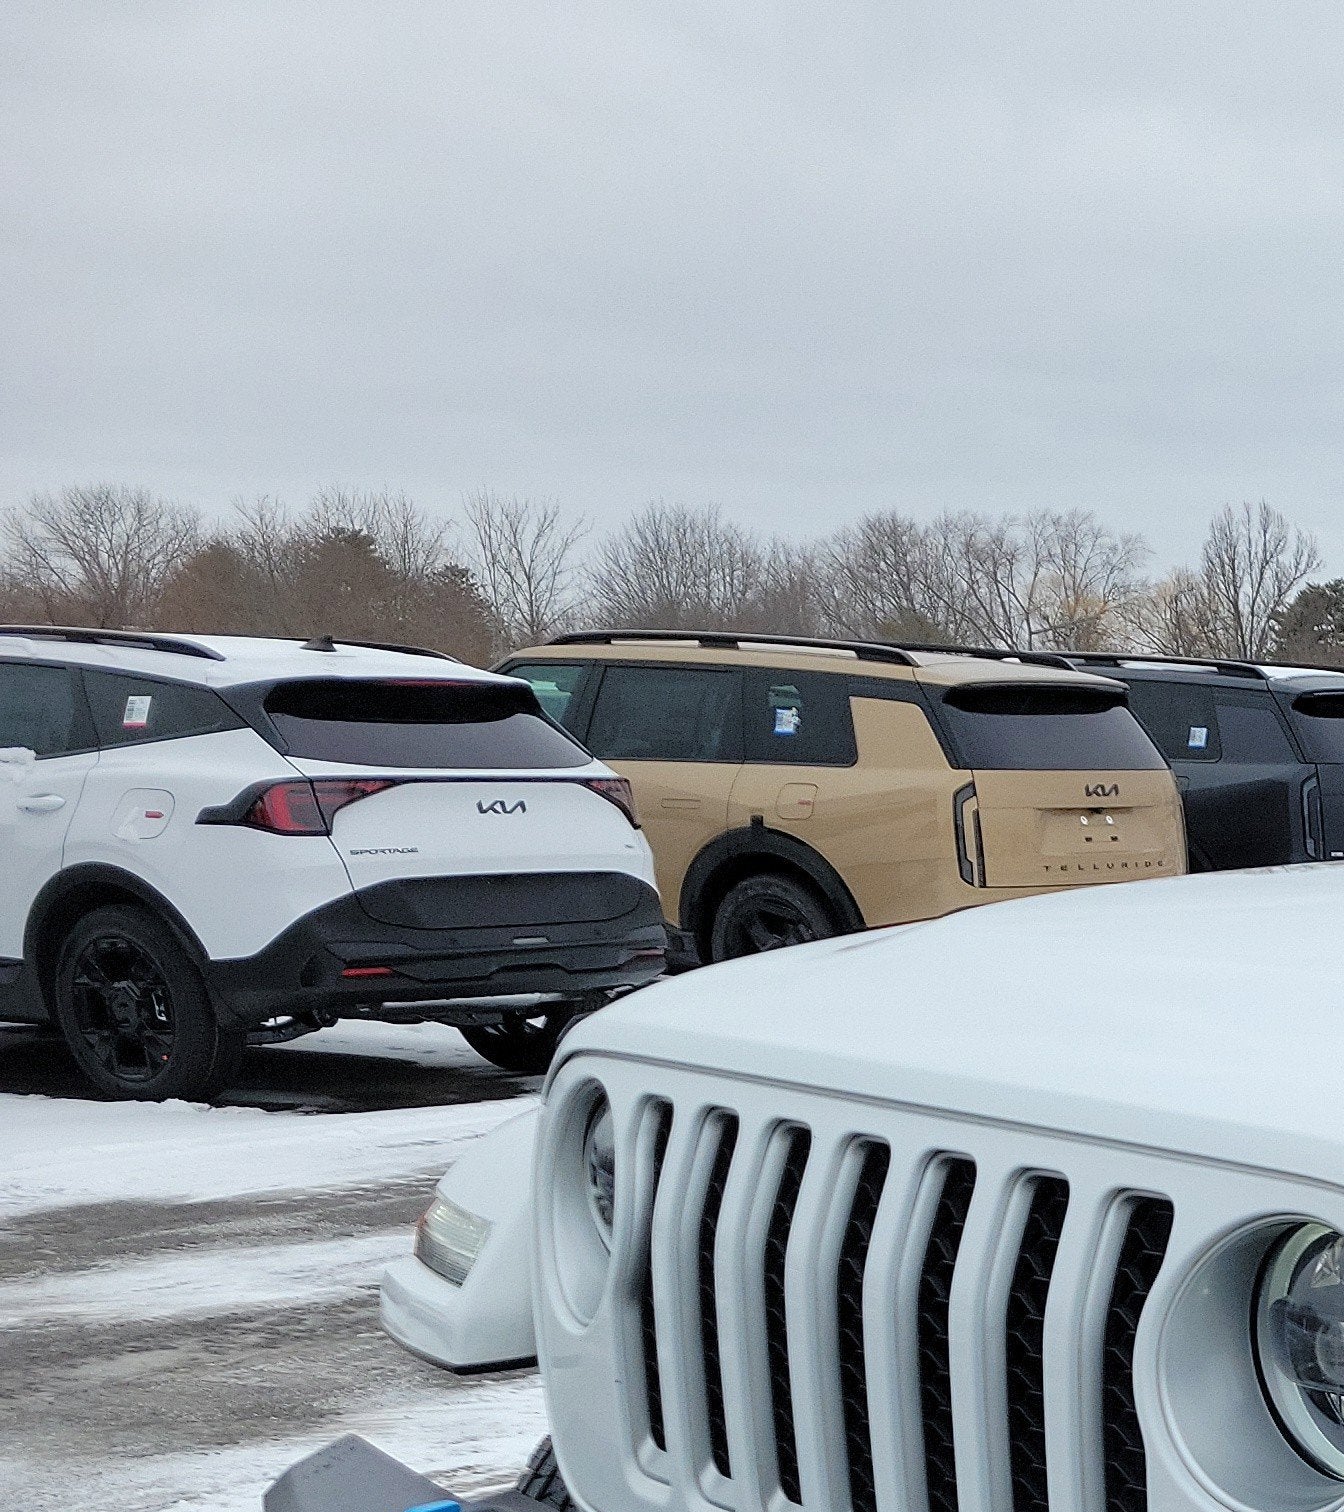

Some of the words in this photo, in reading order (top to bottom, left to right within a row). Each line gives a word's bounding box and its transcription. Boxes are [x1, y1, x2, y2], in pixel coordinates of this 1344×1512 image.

[1084, 783, 1119, 797] KIA
[475, 799, 527, 814] KIA
[350, 847, 418, 855] SPORTAGE
[1043, 860, 1164, 874] TELLURIDE
